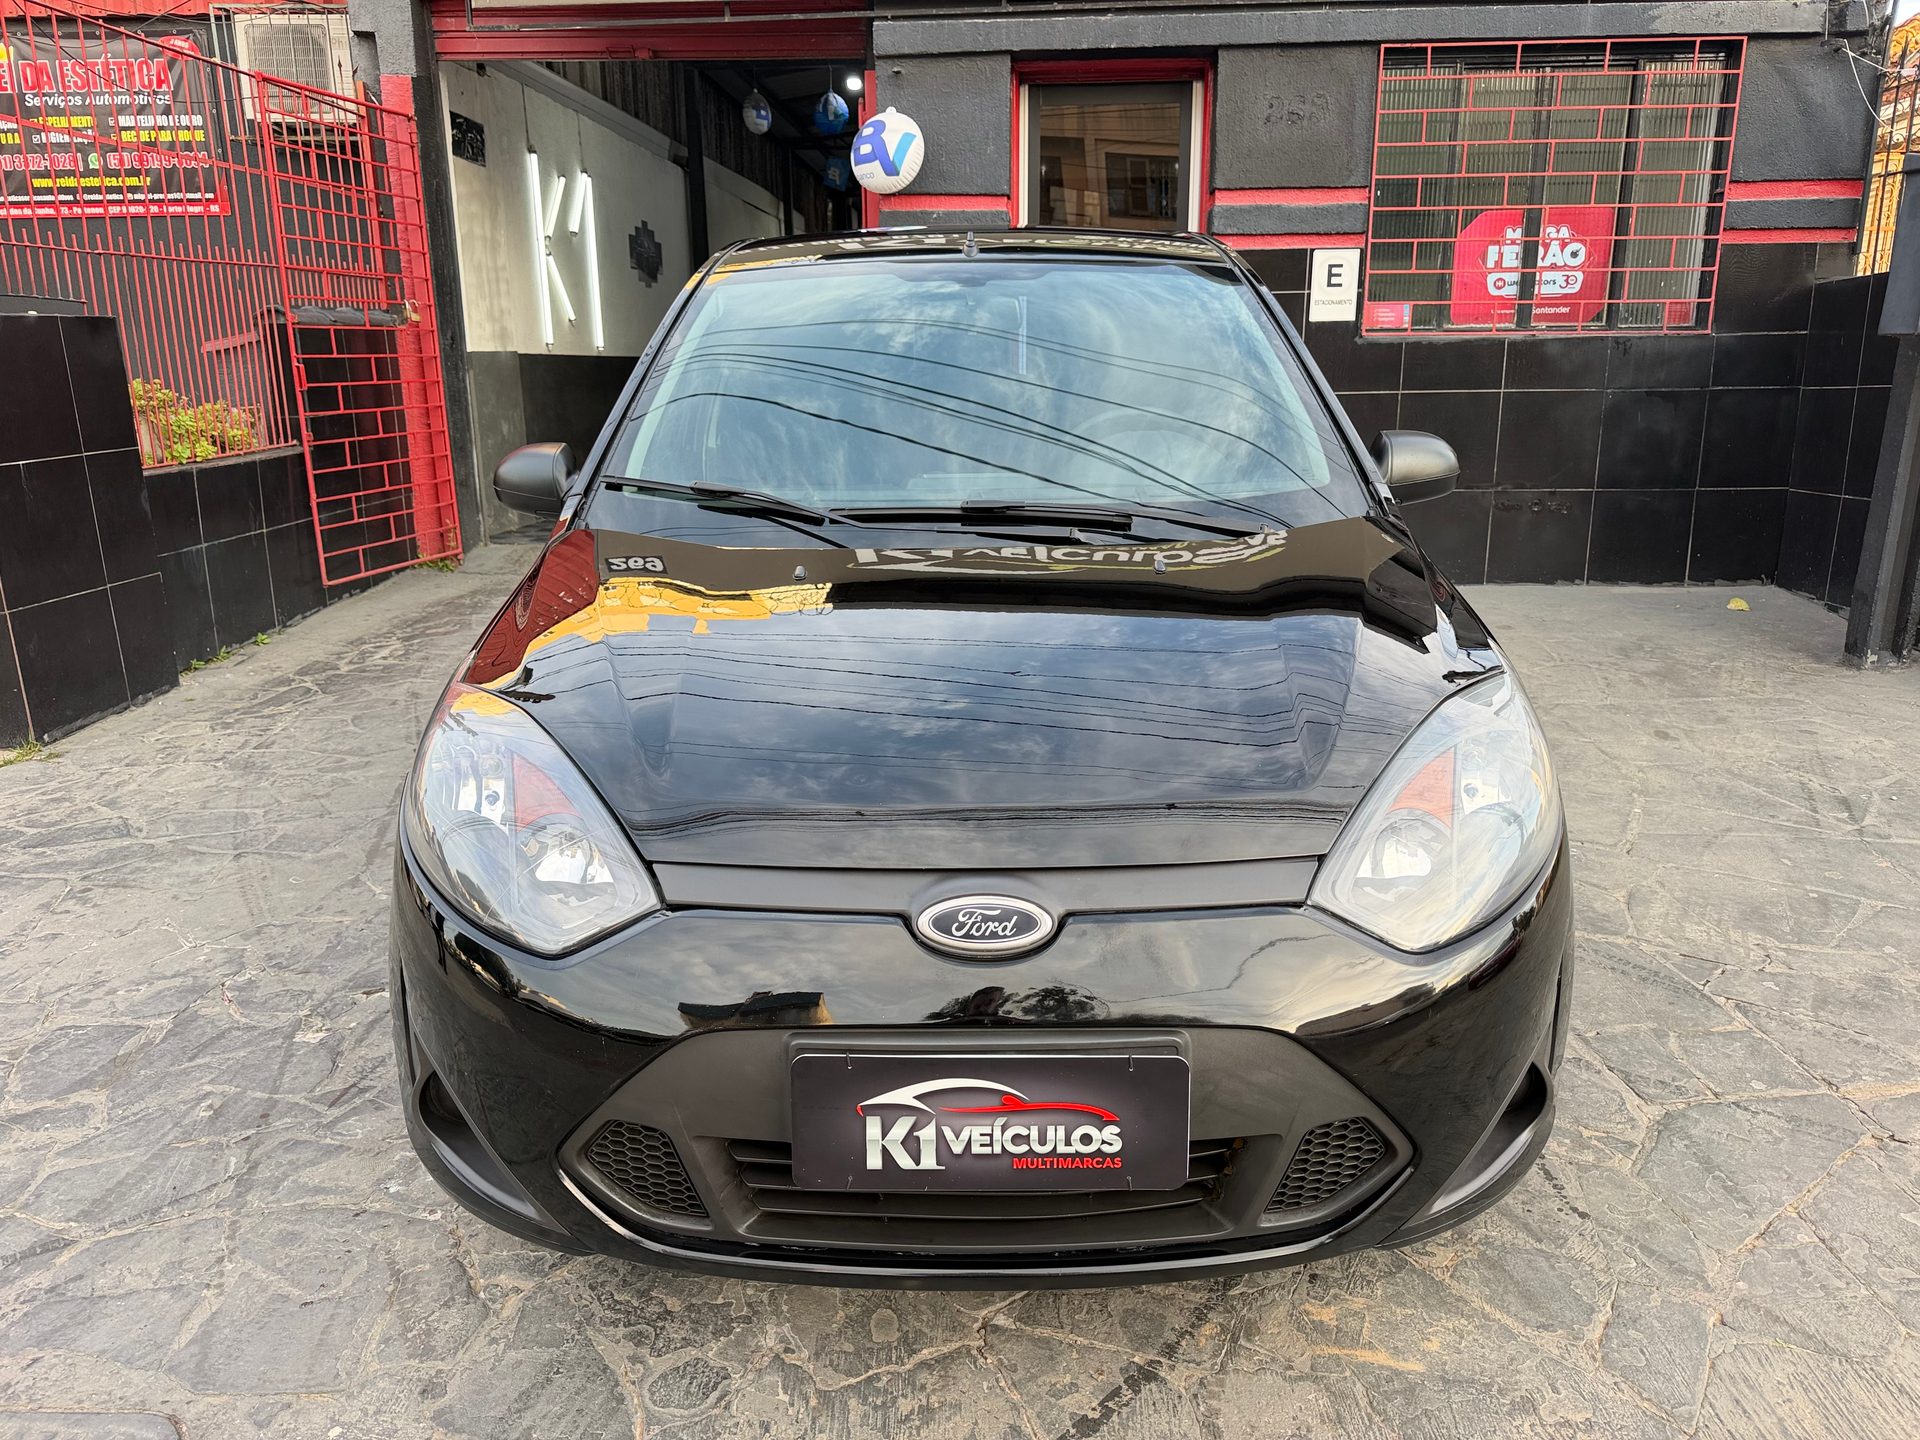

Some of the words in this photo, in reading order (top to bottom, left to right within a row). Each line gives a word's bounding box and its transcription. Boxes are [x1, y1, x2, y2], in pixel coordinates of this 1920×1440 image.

[18, 59, 56, 93] DA
[56, 53, 174, 93] ESTÉTICA
[24, 93, 82, 108] Serviços
[0, 132, 21, 144] URA
[1505, 226, 1571, 243] MGA
[1486, 239, 1586, 268] FERÃO
[1327, 264, 1344, 288] E
[951, 908, 1018, 937] Ford
[866, 1116, 945, 1170] K1
[941, 1117, 1122, 1154] VEÍCULOS
[1013, 1157, 1122, 1169] MULTIMARCAS
